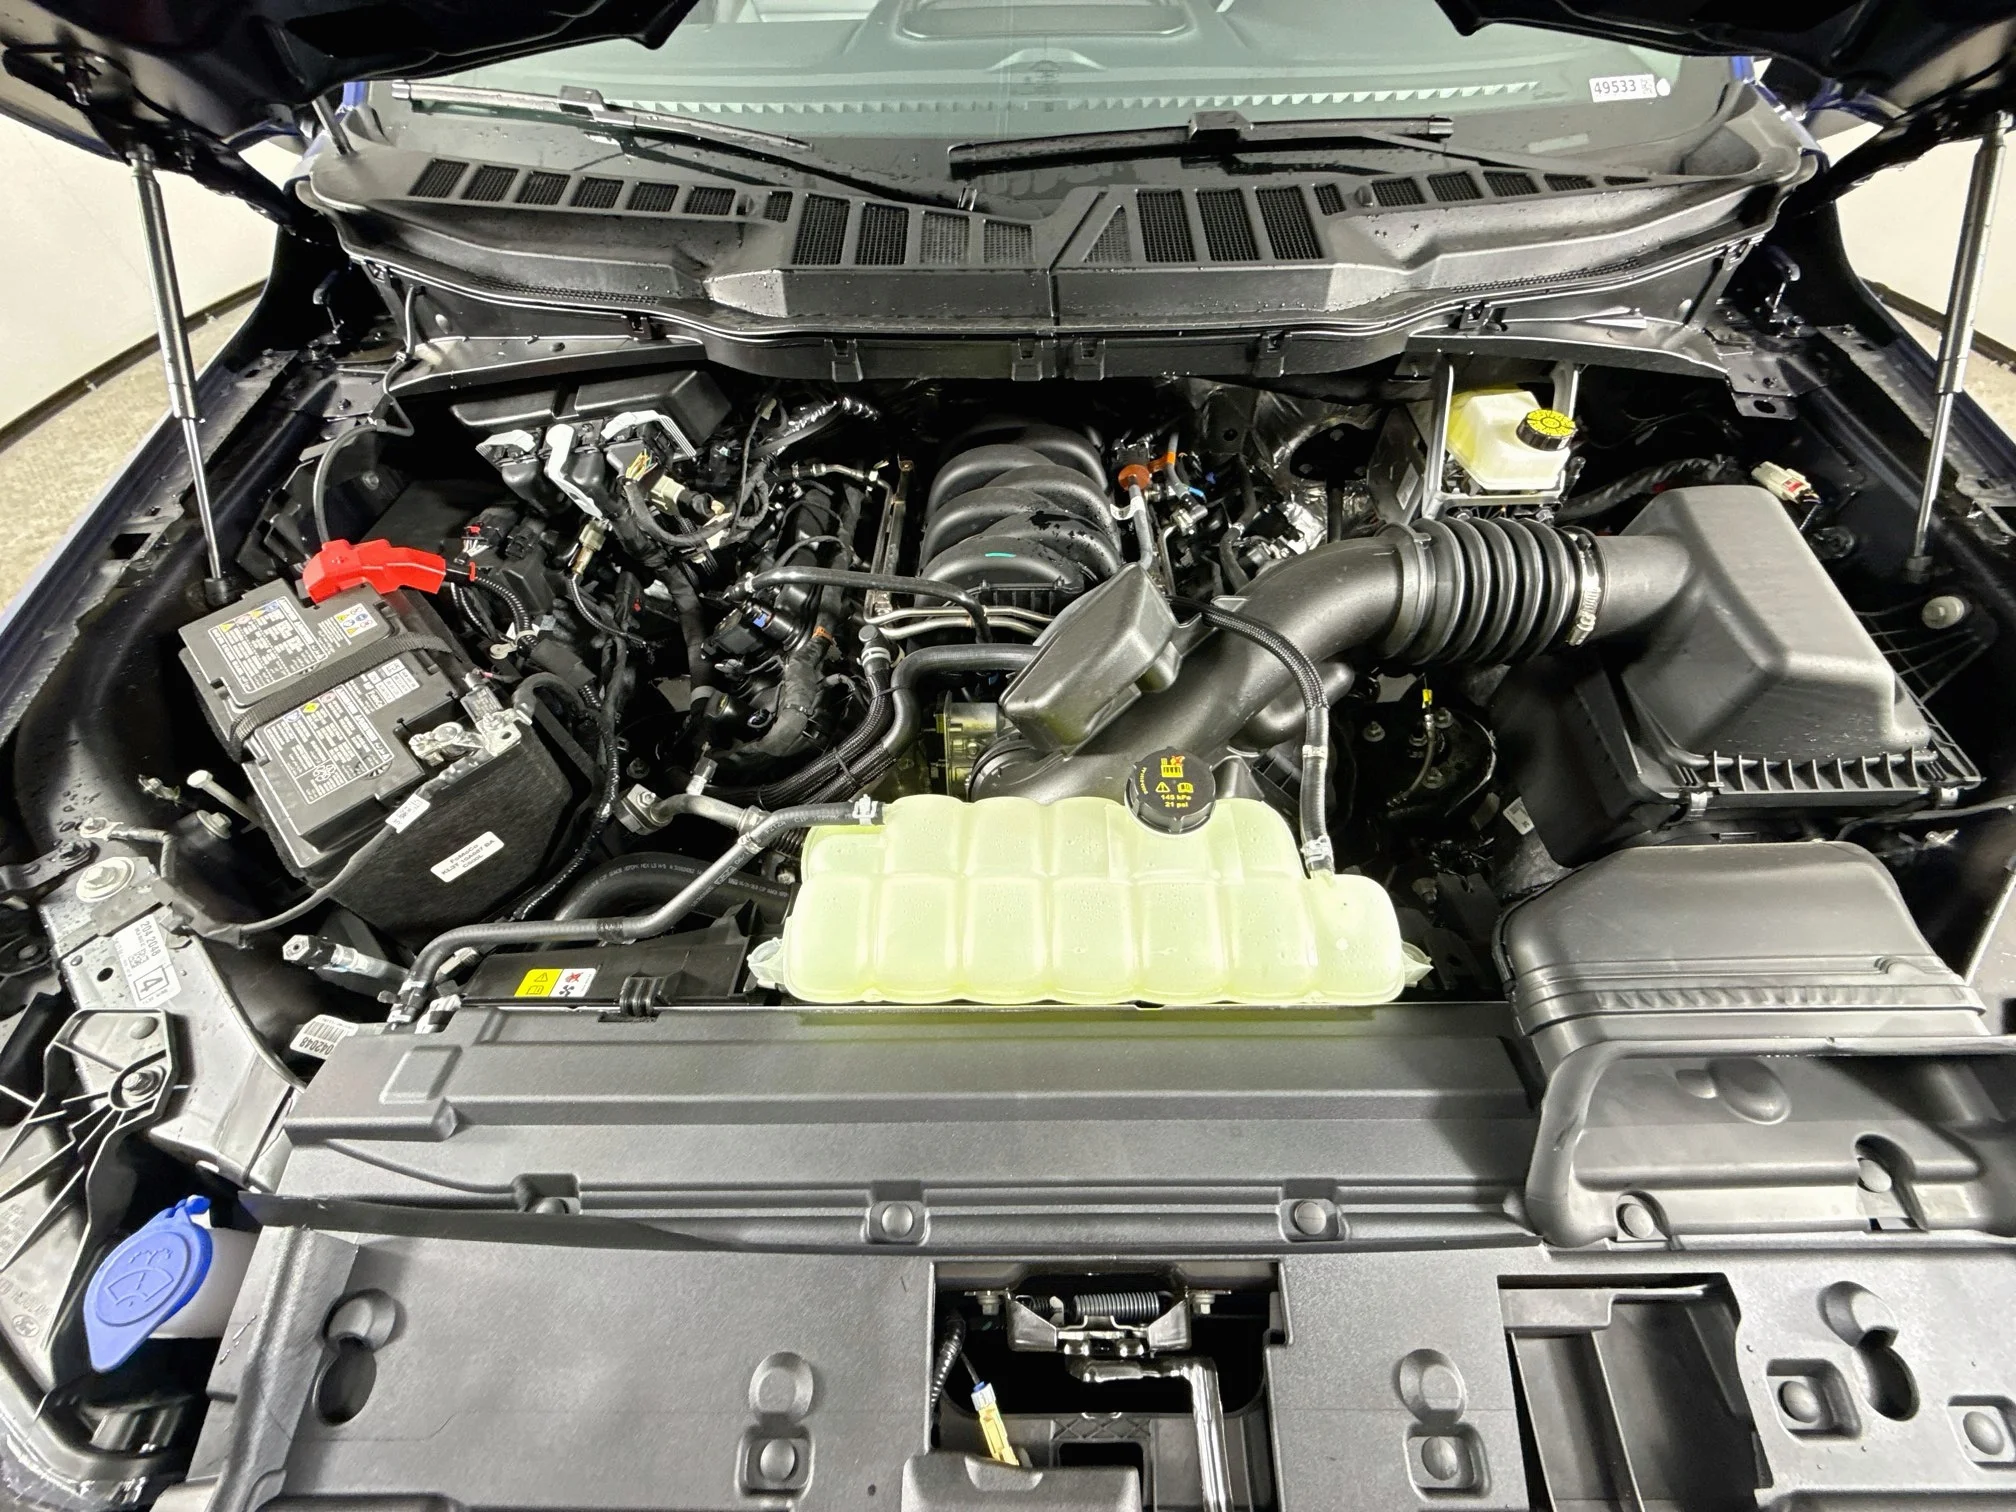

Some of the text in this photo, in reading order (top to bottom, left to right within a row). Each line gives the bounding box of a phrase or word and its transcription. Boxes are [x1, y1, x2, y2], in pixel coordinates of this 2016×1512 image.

[1594, 79, 1637, 94] 49533
[1176, 801, 1189, 809] psi
[449, 843, 480, 864] FoMoCo
[140, 920, 151, 938] 204
[146, 935, 163, 958] 2048
[140, 976, 164, 994] 4
